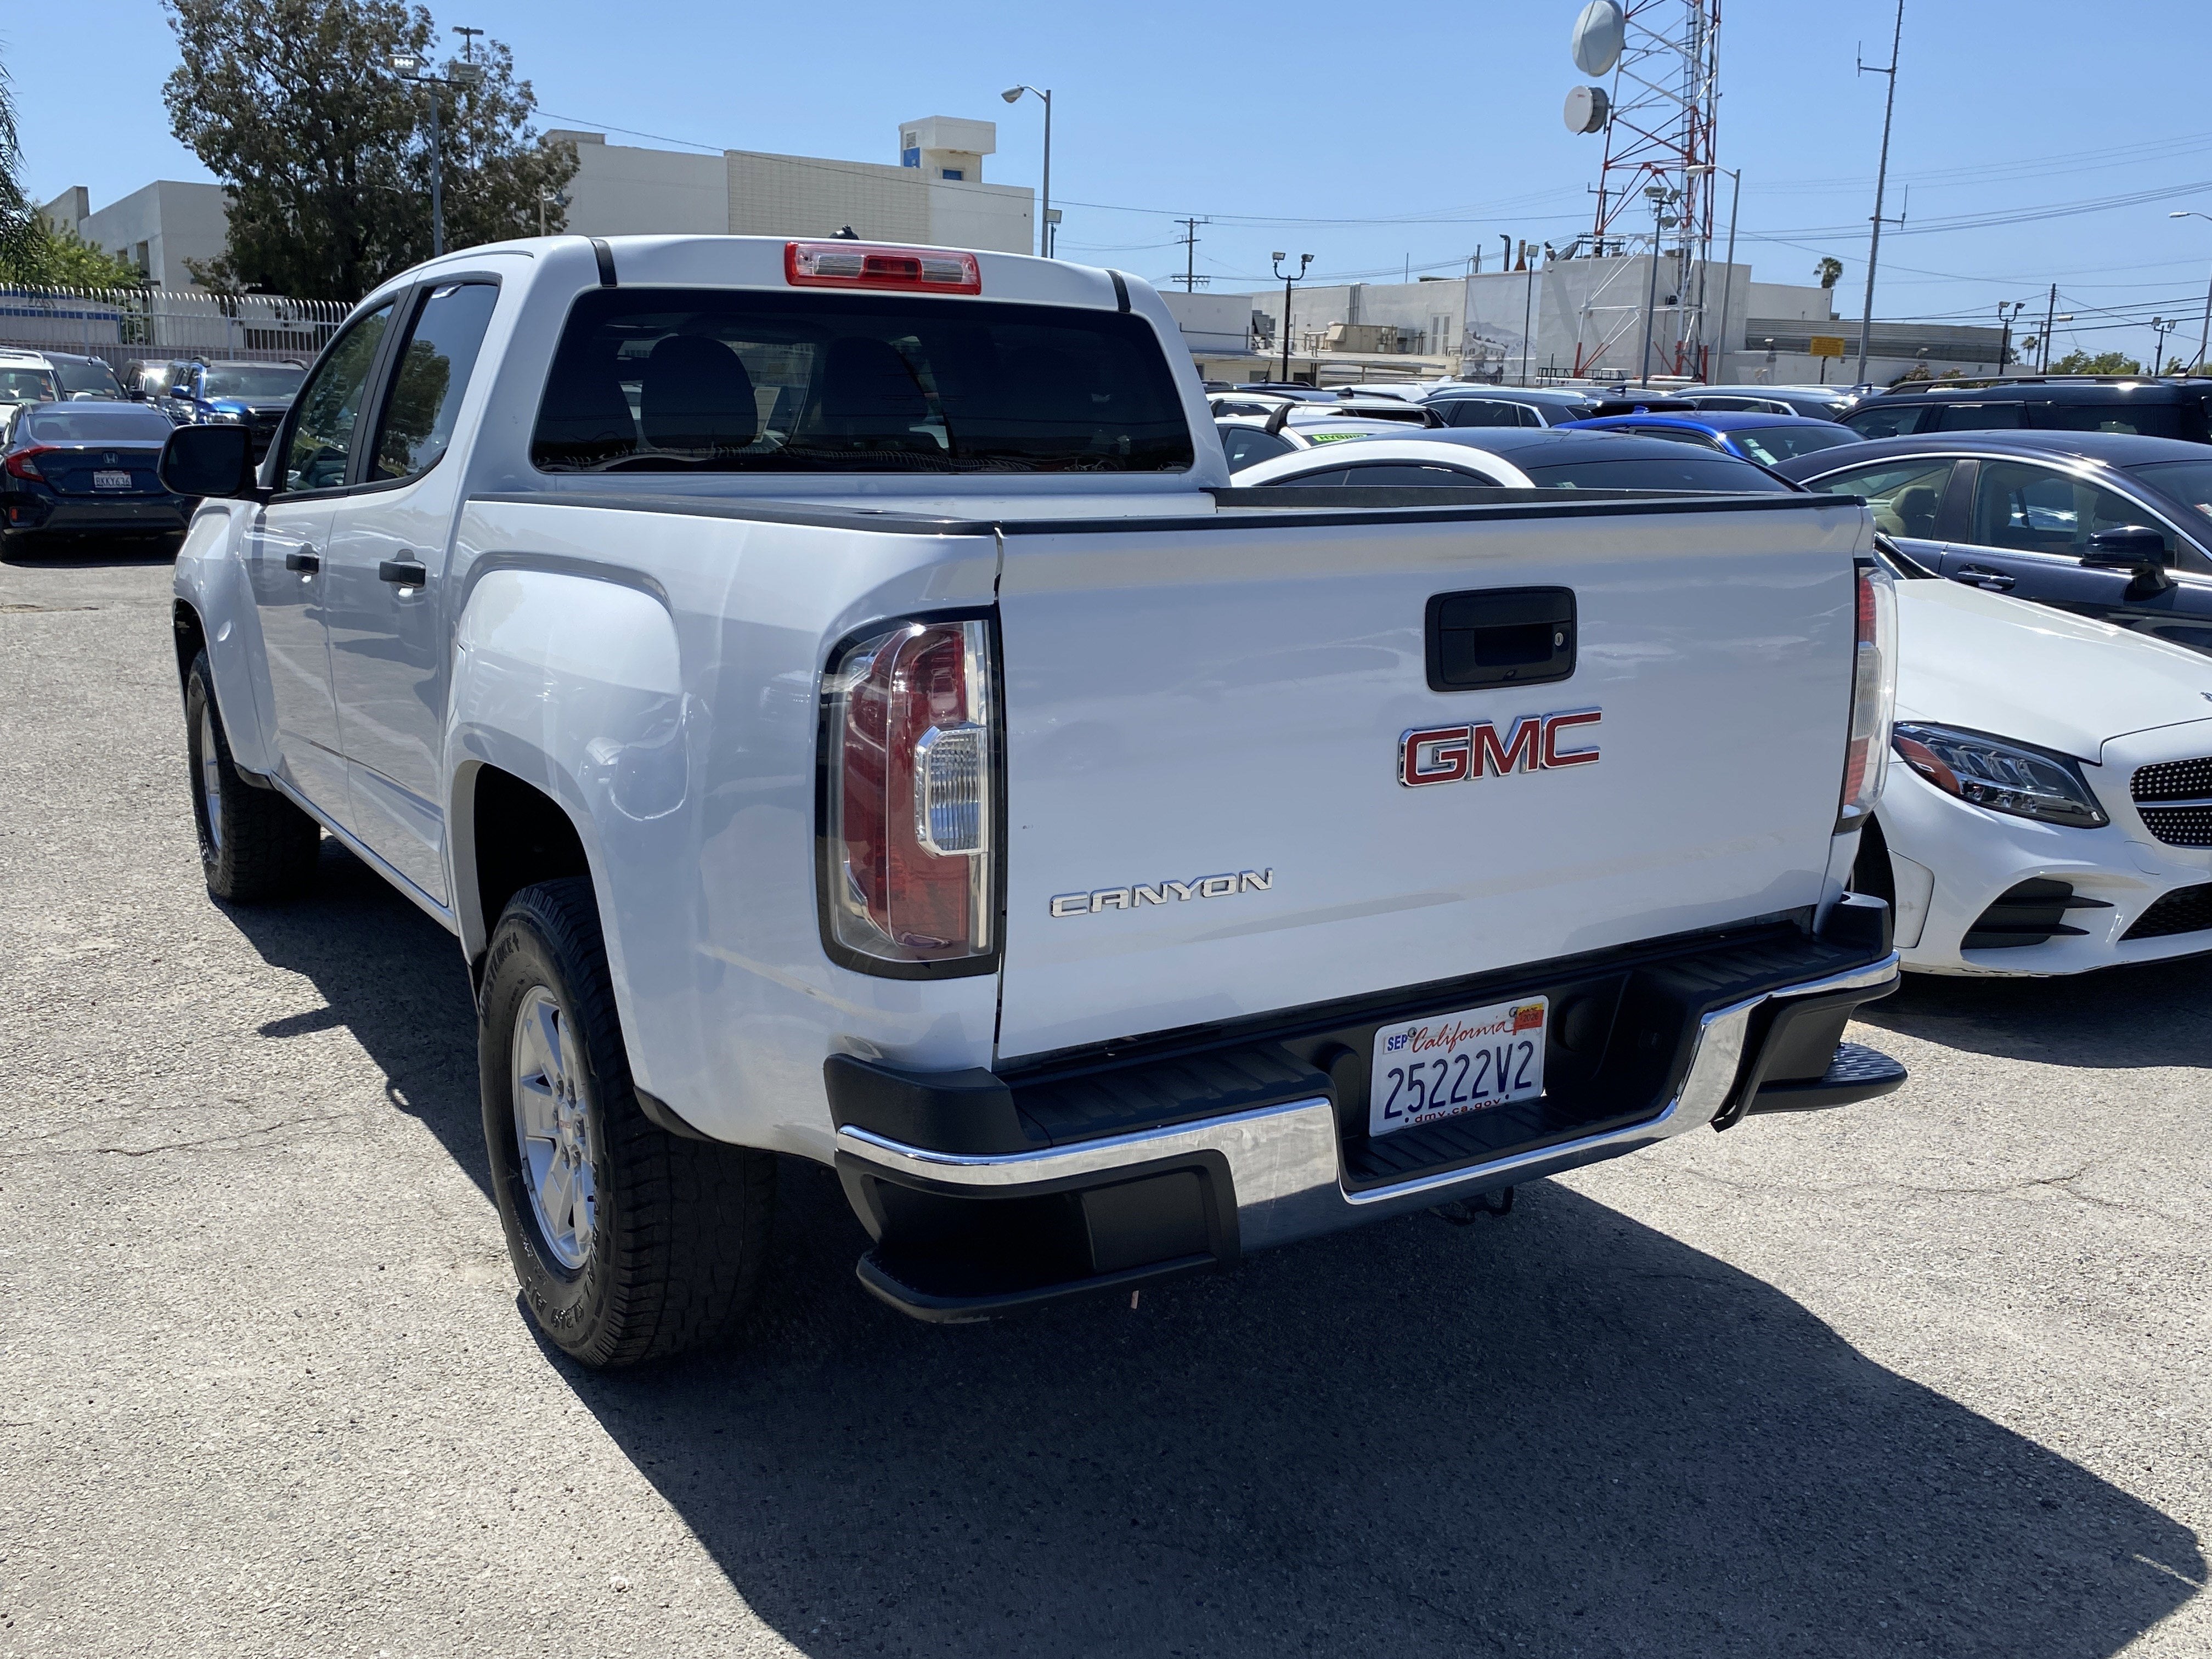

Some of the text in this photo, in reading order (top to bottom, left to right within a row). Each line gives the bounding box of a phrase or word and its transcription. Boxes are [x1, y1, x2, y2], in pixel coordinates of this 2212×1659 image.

[1398, 706, 1602, 787] GMC
[1049, 867, 1273, 917] CANYON
[1412, 1015, 1514, 1053] California
[1523, 1012, 1539, 1022] 2026
[1387, 1034, 1408, 1052] SEP
[1384, 1041, 1534, 1120] 25222V2
[1415, 1098, 1502, 1124] dmv.ca.gov
